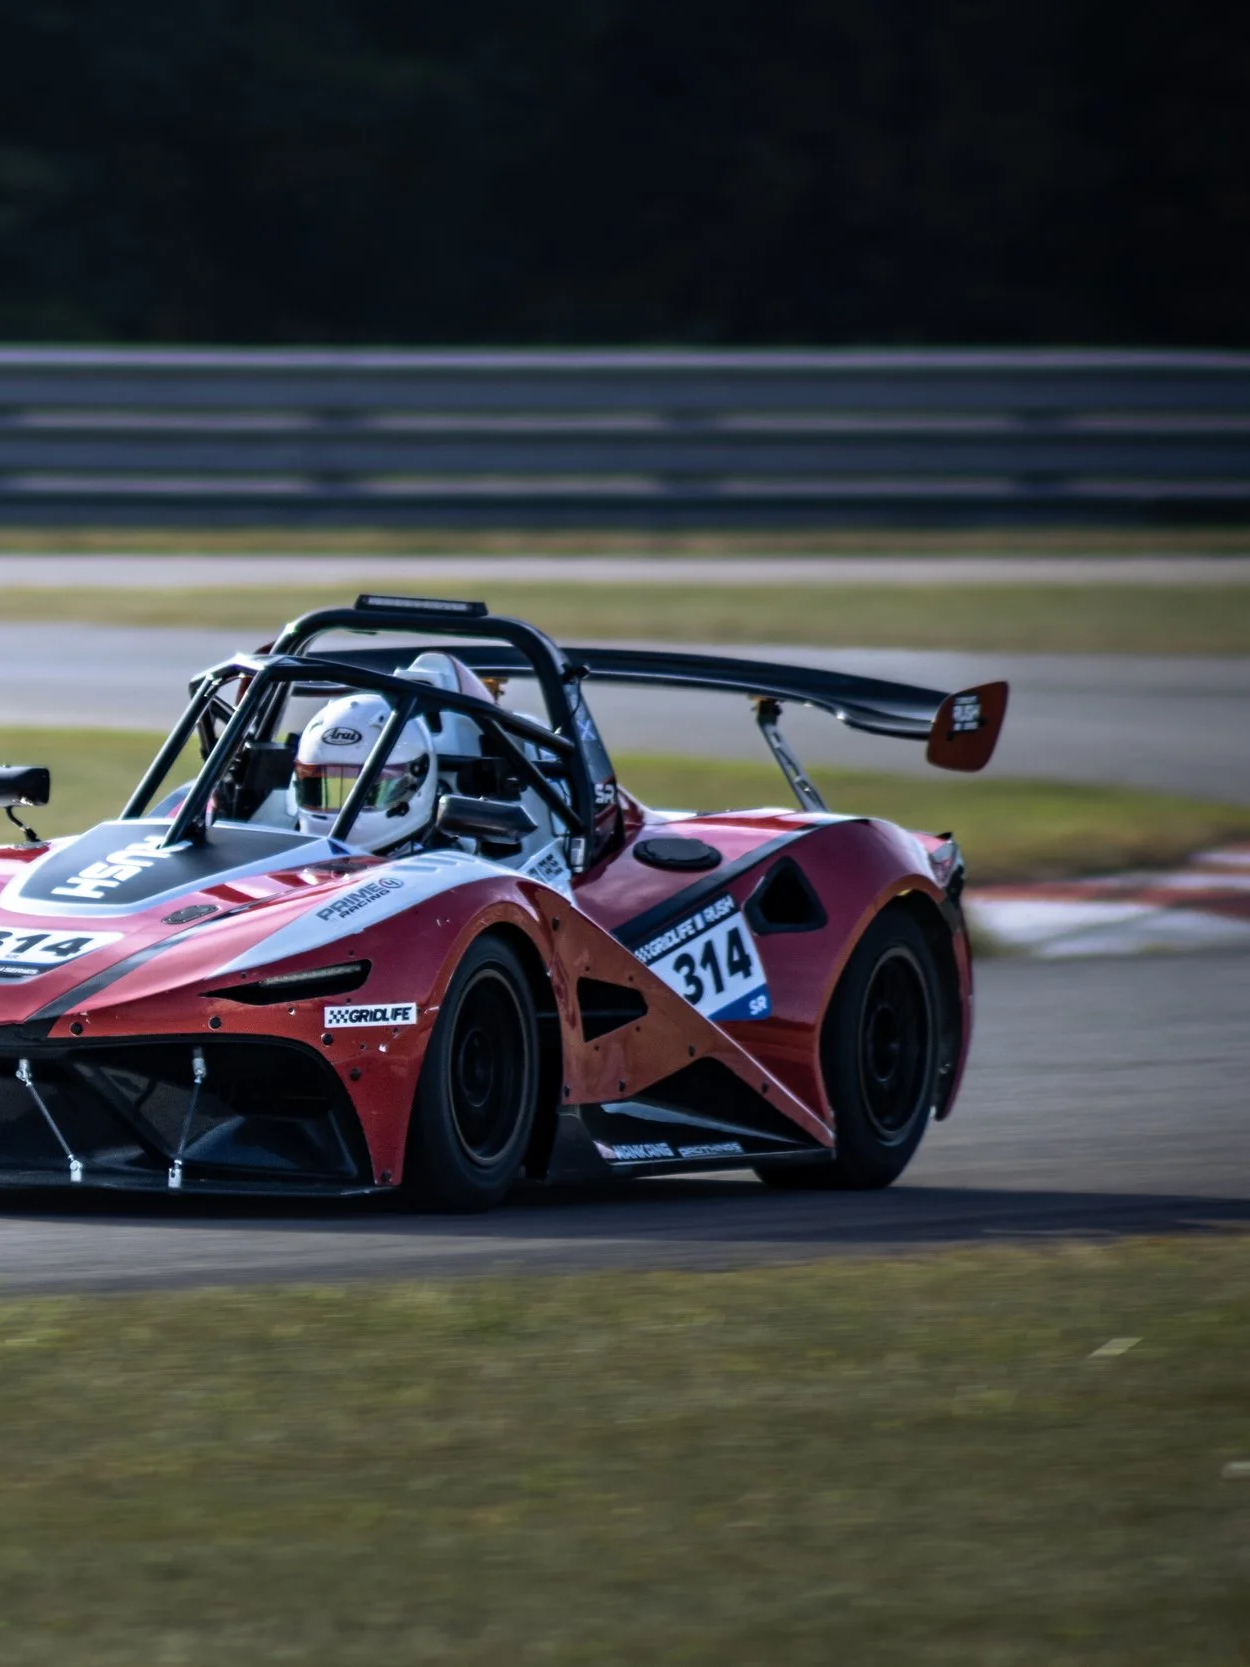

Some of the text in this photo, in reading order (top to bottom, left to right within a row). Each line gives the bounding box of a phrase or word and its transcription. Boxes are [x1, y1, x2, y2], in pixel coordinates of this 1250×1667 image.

[323, 727, 356, 741] Arai
[316, 882, 383, 921] PRIME
[339, 889, 391, 918] RACING
[650, 894, 735, 959] GRIDLIFE RUSH
[673, 926, 753, 1006] 314
[349, 1006, 413, 1024] GRIDLIFE
[749, 994, 768, 1016] SR
